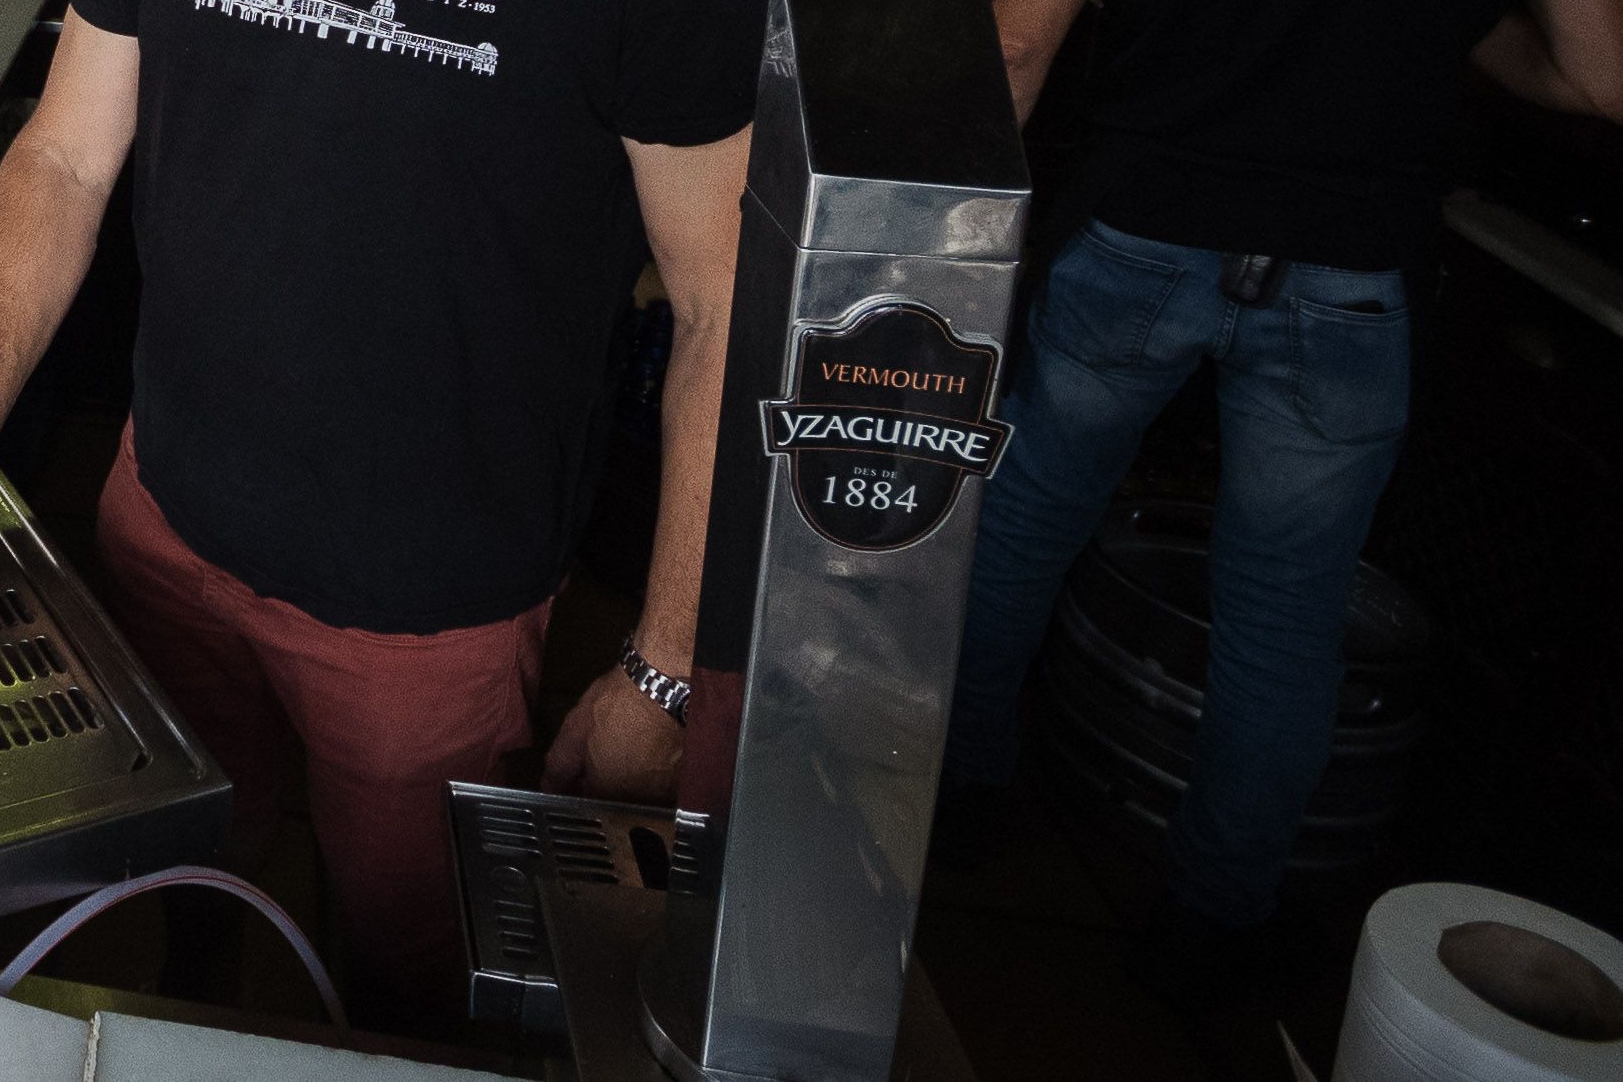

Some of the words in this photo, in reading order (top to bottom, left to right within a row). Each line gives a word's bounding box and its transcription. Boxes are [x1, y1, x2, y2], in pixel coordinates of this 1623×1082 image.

[821, 361, 967, 395] VERMOUTH
[776, 410, 991, 463] YZAGUIRRE
[822, 475, 918, 514] 1884
